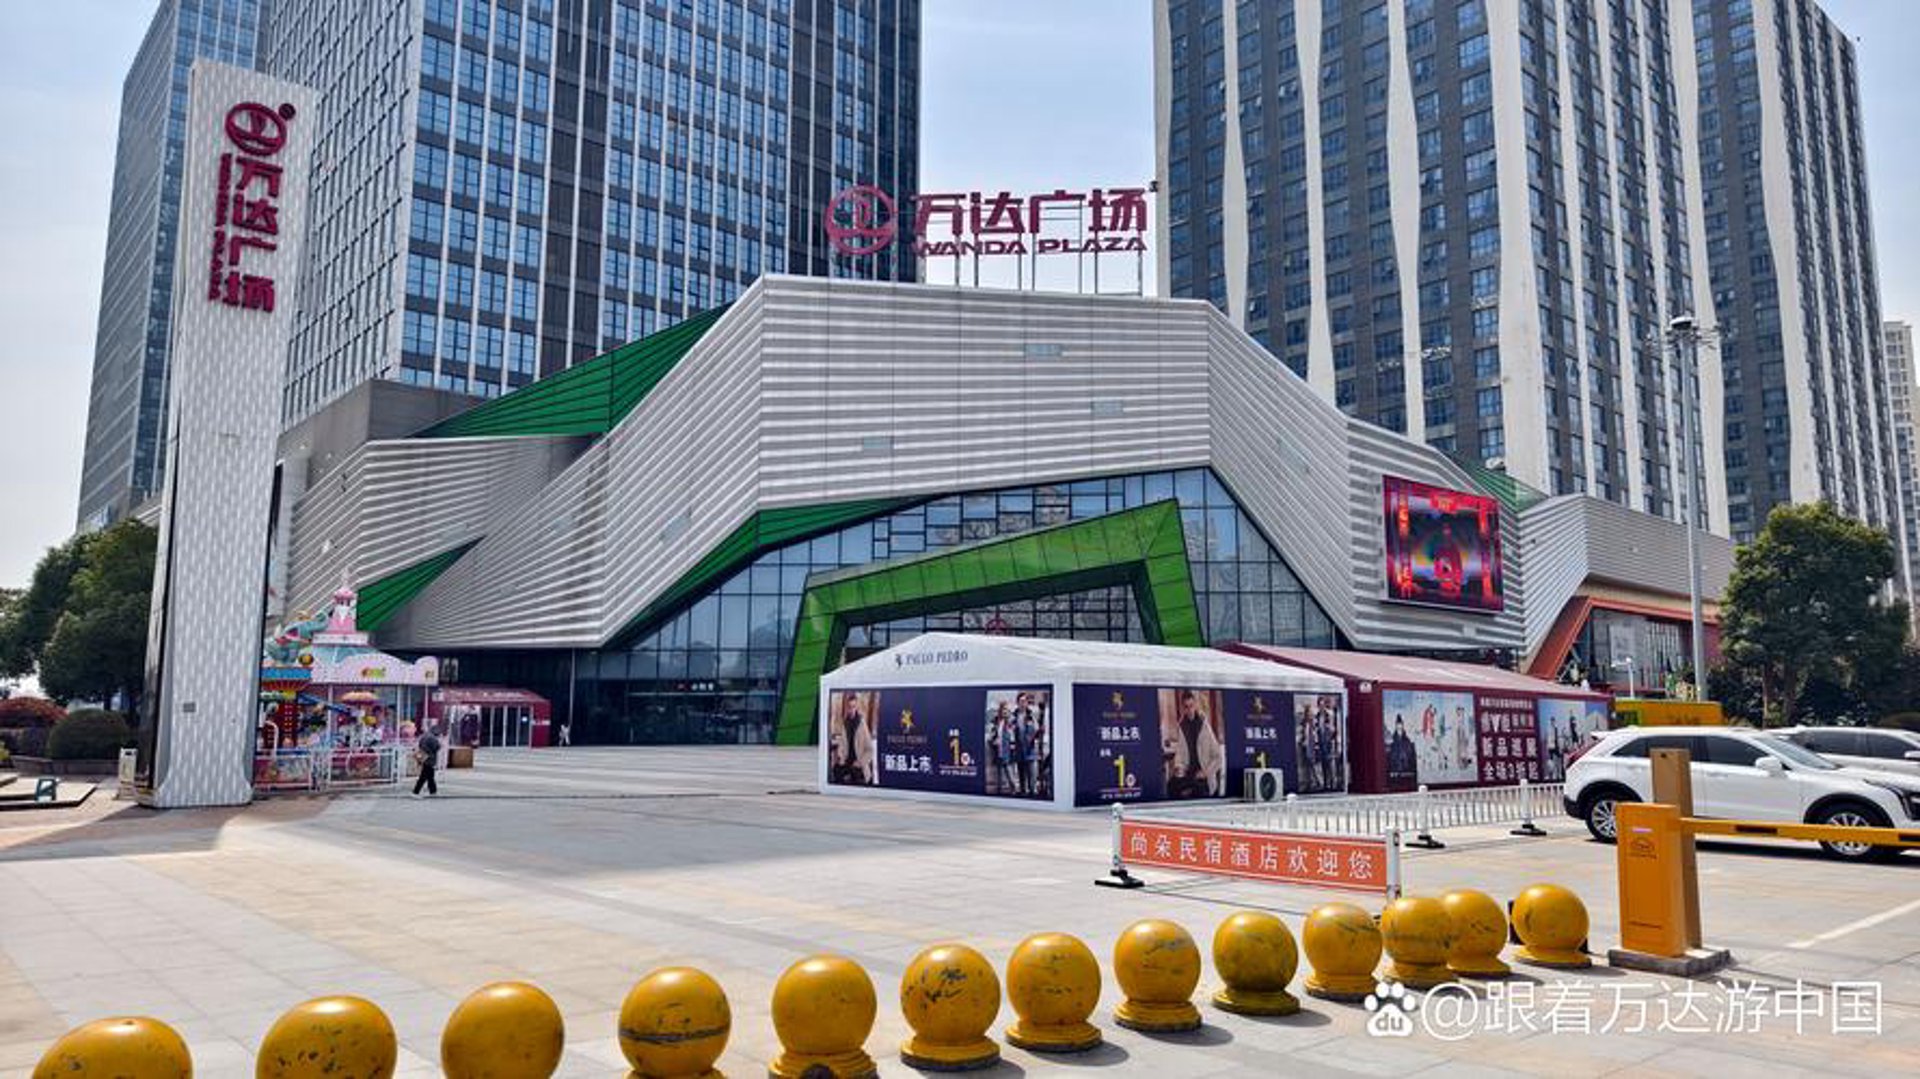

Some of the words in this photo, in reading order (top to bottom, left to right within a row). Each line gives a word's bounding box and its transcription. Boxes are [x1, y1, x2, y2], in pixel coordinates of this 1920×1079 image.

[912, 188, 1148, 234] 万达广场
[222, 156, 283, 313] 万达广场
[916, 240, 1029, 257] WANDA
[1038, 236, 1148, 254] PLAZA
[885, 754, 932, 773] 新品上市
[1131, 831, 1374, 880] 尚朵民宿酒店欢迎您
